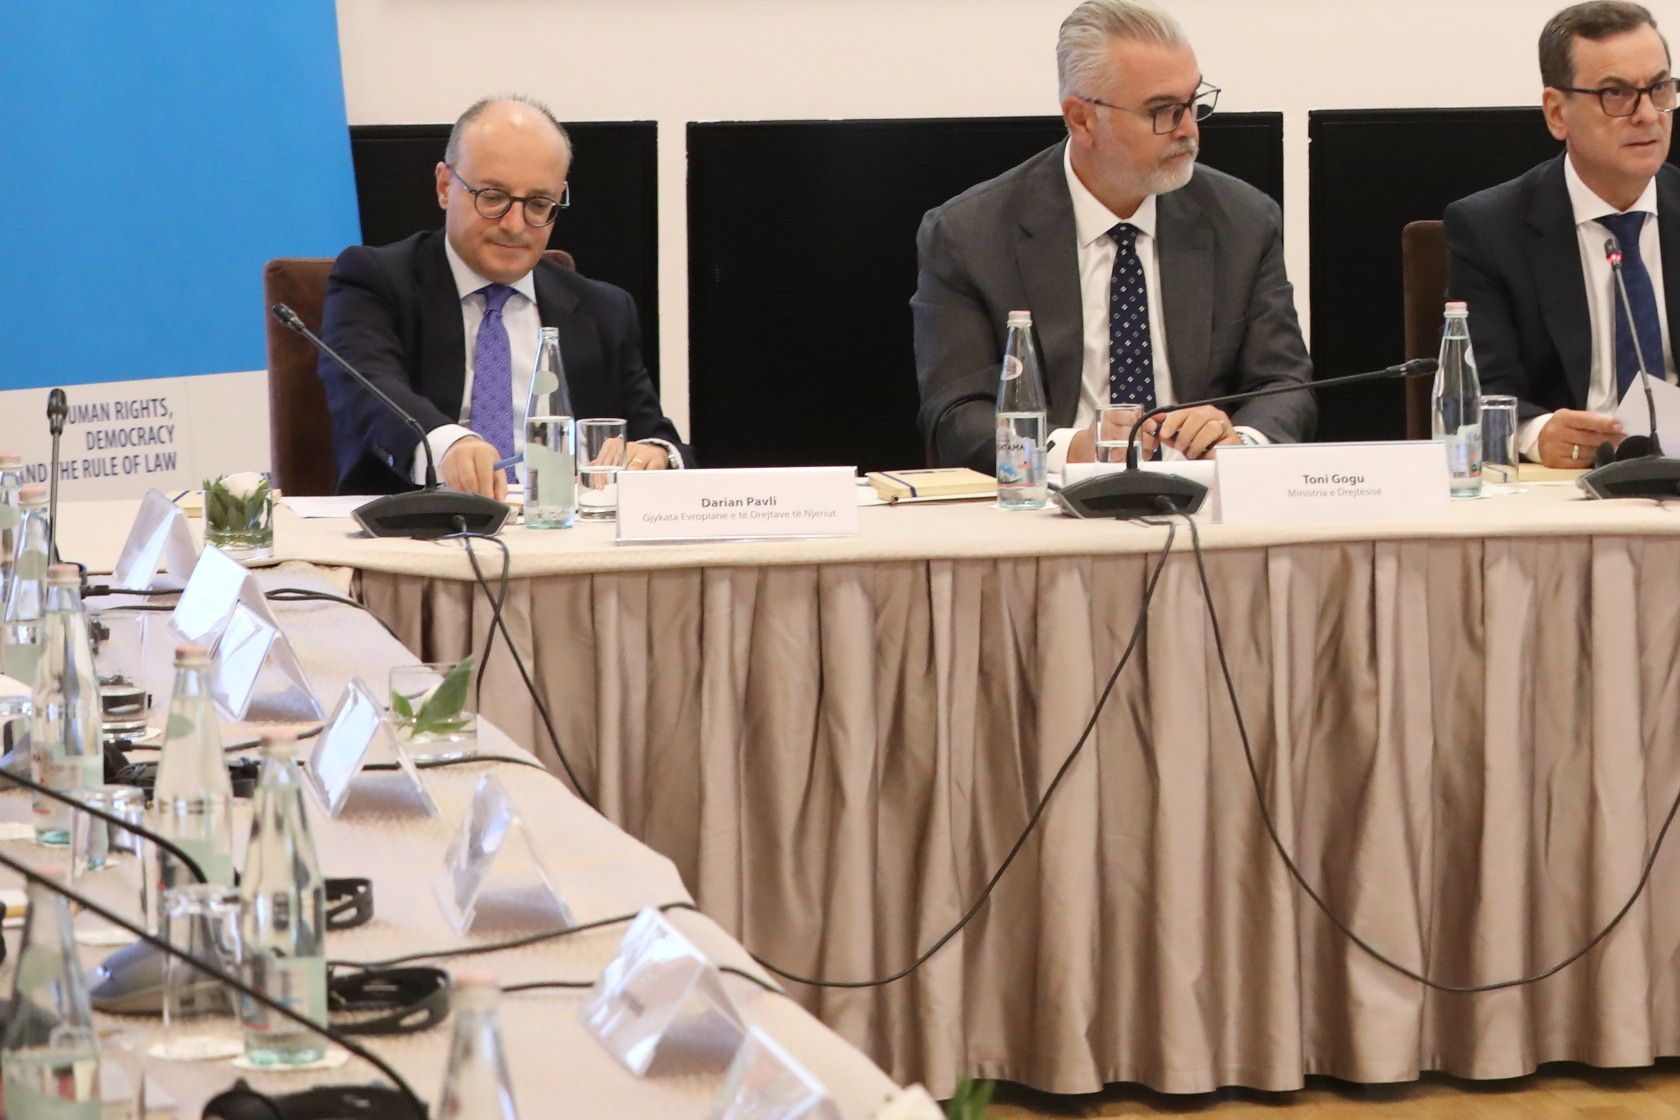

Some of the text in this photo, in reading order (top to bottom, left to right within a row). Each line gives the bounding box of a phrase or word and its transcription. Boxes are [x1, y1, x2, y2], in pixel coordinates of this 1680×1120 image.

[64, 397, 174, 425] UMAN RIGHTS,
[86, 425, 176, 451] DEMOCRACY
[83, 456, 118, 479] RULE
[123, 454, 141, 475] OF
[145, 451, 177, 472] LAW
[1302, 473, 1365, 486] Toni Gogu
[1287, 487, 1328, 498] Ministria
[701, 495, 777, 508] Darian Pavli
[641, 511, 679, 525] Gjykata
[681, 511, 728, 523] Evropiane
[750, 509, 790, 523] Drejtave
